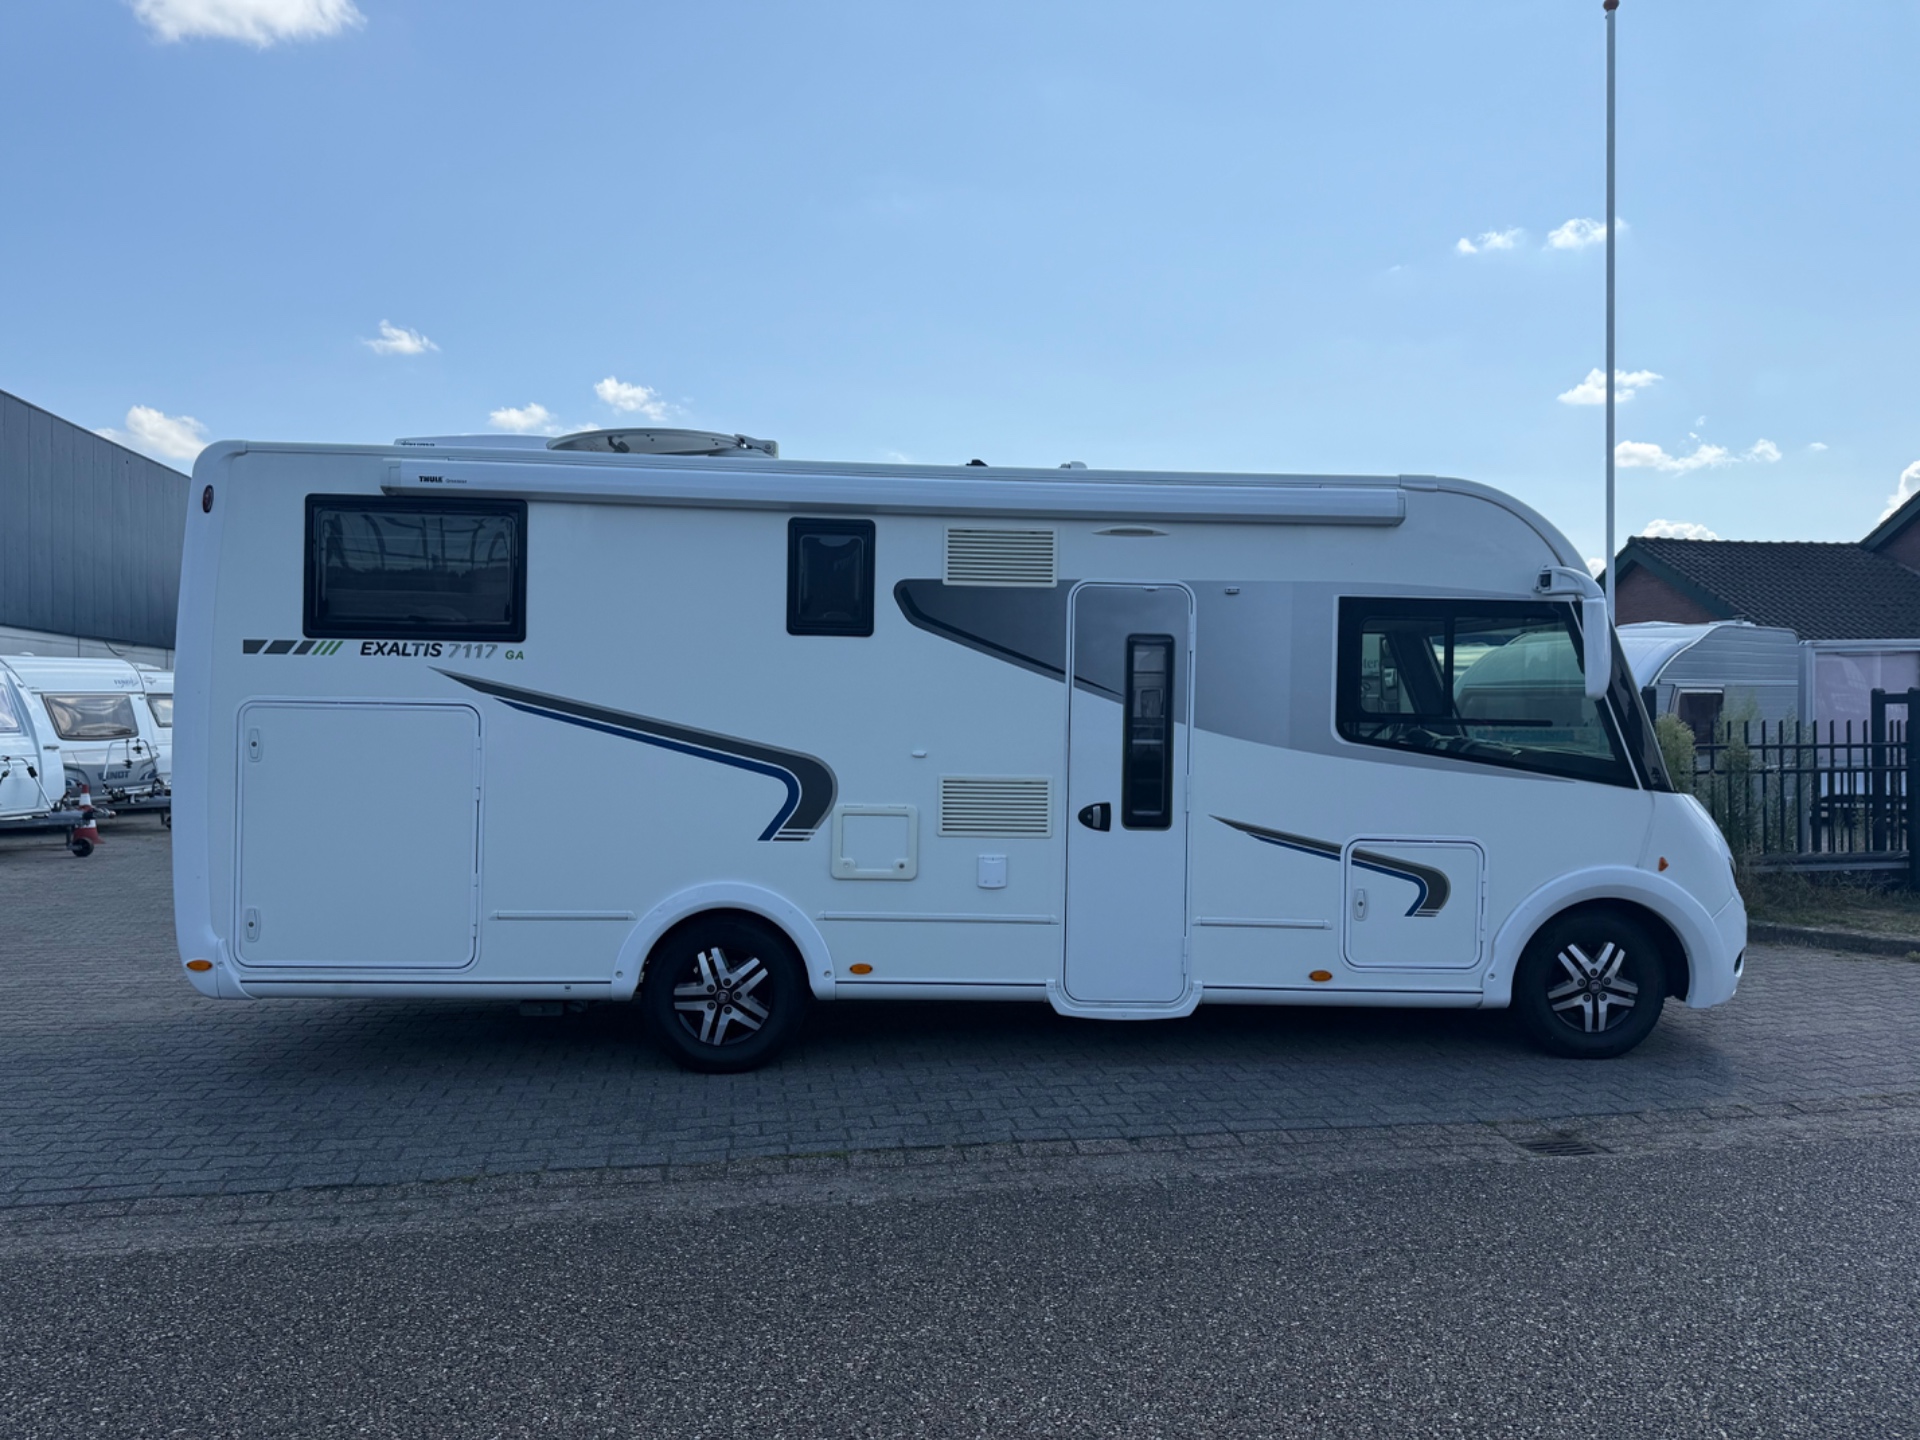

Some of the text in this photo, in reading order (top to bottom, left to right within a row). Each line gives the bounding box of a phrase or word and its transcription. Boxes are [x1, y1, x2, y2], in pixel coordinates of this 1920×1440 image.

[418, 475, 443, 483] THULE
[360, 641, 524, 660] EXALTIS 7117 GA
